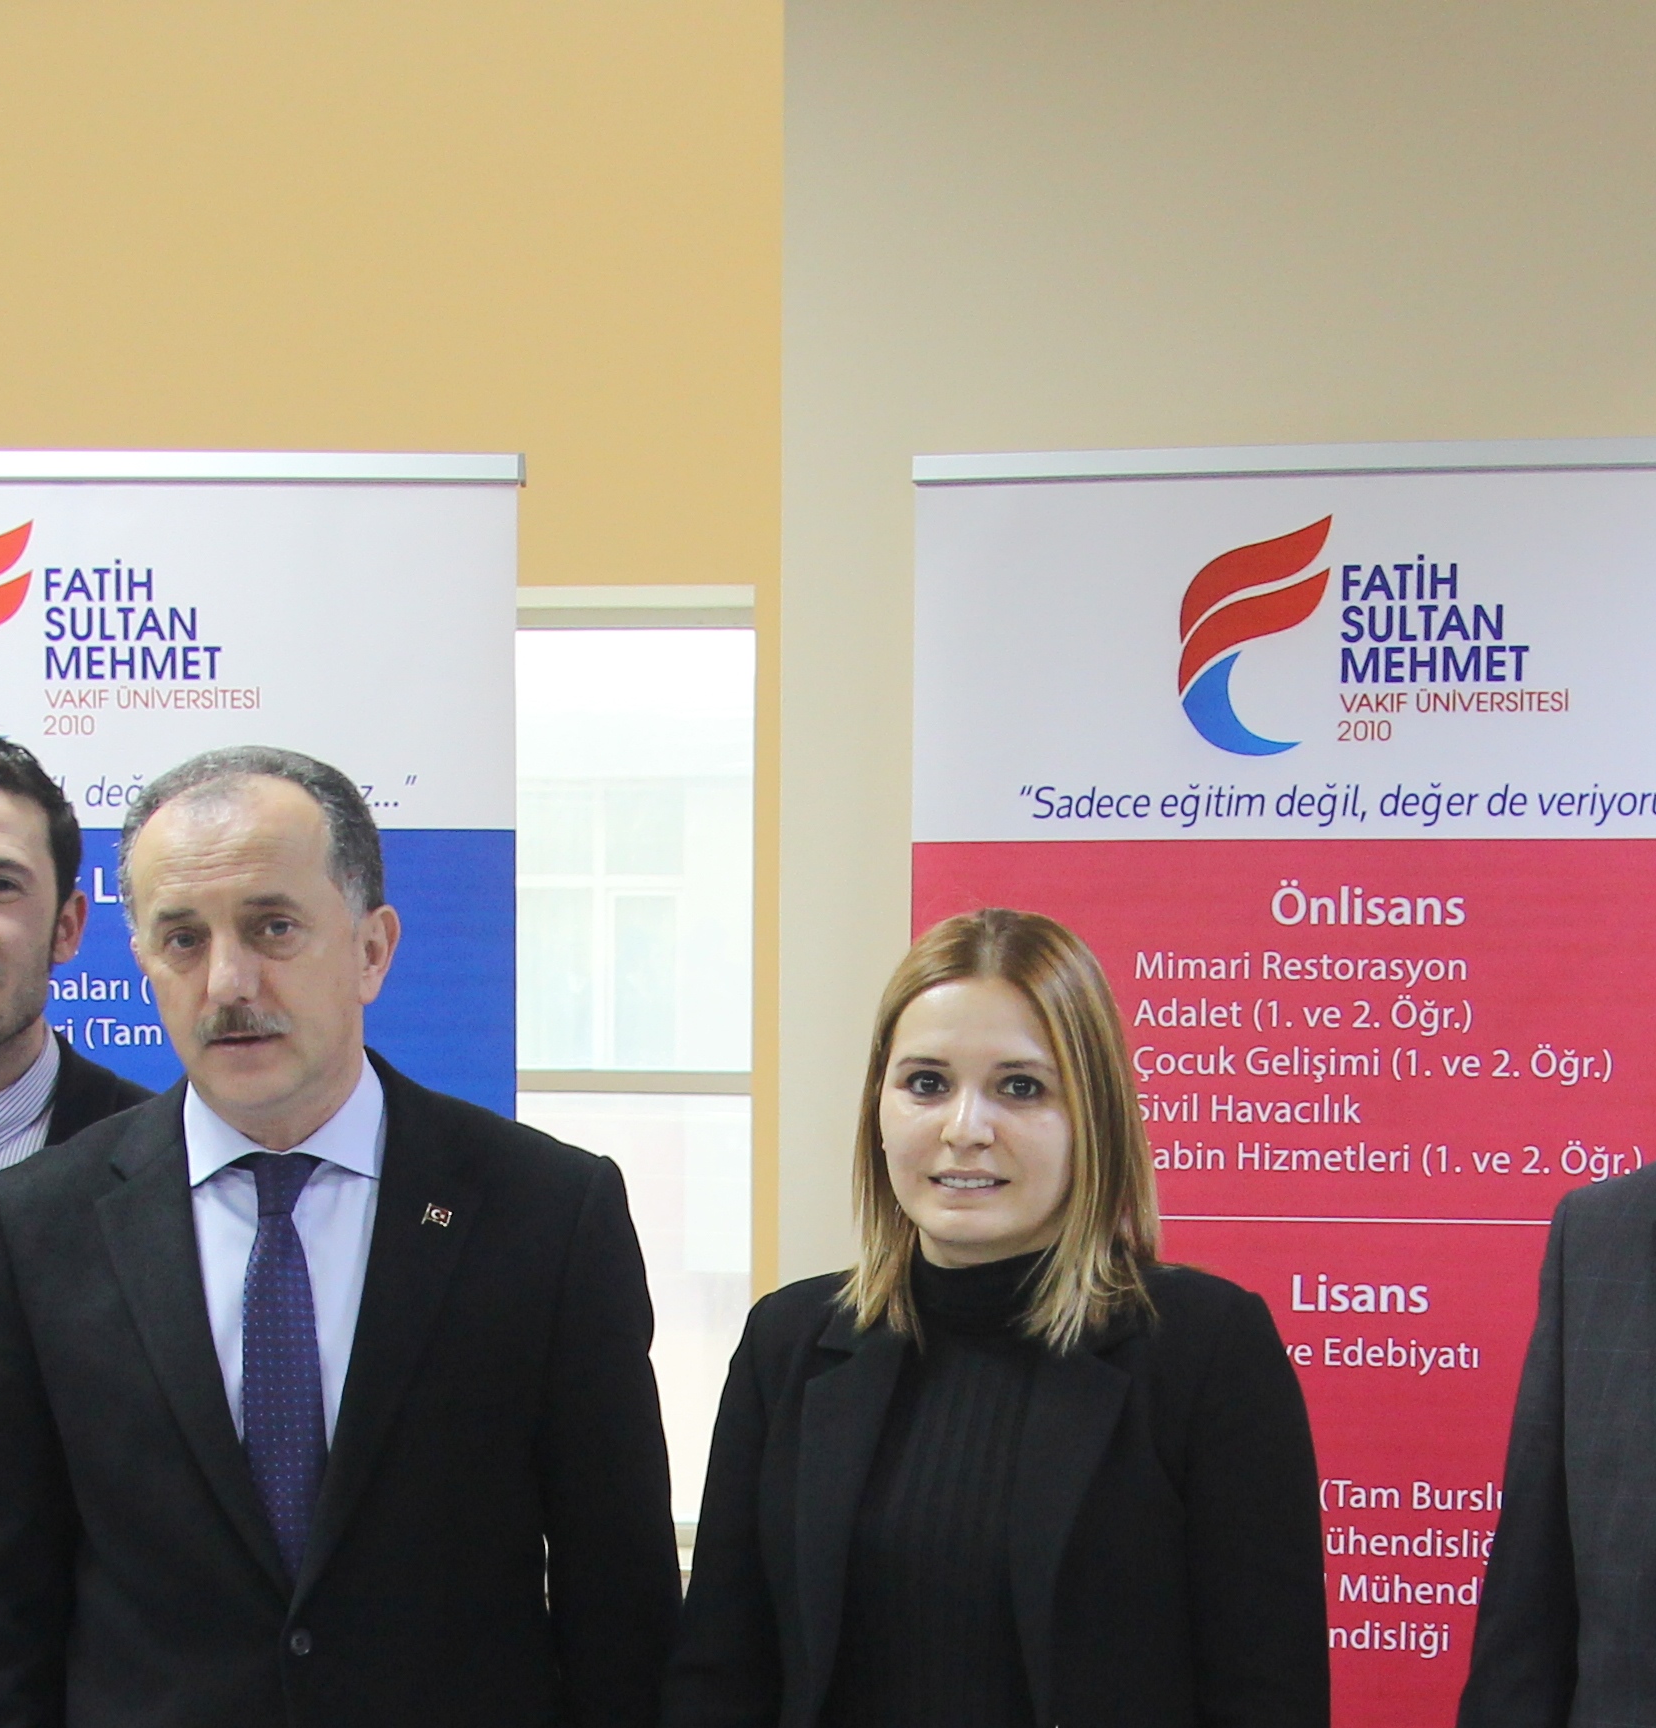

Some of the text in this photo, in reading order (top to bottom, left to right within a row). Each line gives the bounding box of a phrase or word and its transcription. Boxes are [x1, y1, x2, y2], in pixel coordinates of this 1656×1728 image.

[44, 558, 153, 601] FATİH
[1341, 554, 1458, 601] FATİH
[44, 607, 197, 641] SULTAN
[1340, 604, 1504, 643] SULTAN
[45, 646, 222, 680] MEHMET
[1340, 645, 1530, 684] MEHMET
[44, 685, 261, 709] VAKIF ÜNİVERSİTESİ
[1339, 688, 1570, 713] VAKIF ÜNİVERSİTESİ
[43, 715, 96, 736] 2010
[1337, 720, 1393, 742] 2010
[1159, 782, 1267, 827] eğitim
[1274, 782, 1367, 827] değil,
[1378, 782, 1479, 827] değer
[1486, 783, 1528, 818] de
[1270, 879, 1466, 926] Önlisans
[1134, 951, 1468, 988] Mimari Restorasyon
[85, 1017, 163, 1050] (Tam
[1133, 994, 1474, 1037] Adalet (1. ve 2. Öğr.)
[1132, 1043, 1614, 1086] Çocuk Gelişimi (1. ve 2. Öğr.)
[1211, 1092, 1362, 1124] Havacılık
[1148, 1140, 1643, 1182] abin Hizmetleri (1. ve 2. Öğr.)
[1291, 1273, 1430, 1314] Lisans
[1323, 1337, 1480, 1376] Edebiyatı
[1319, 1478, 1400, 1512] (Tam
